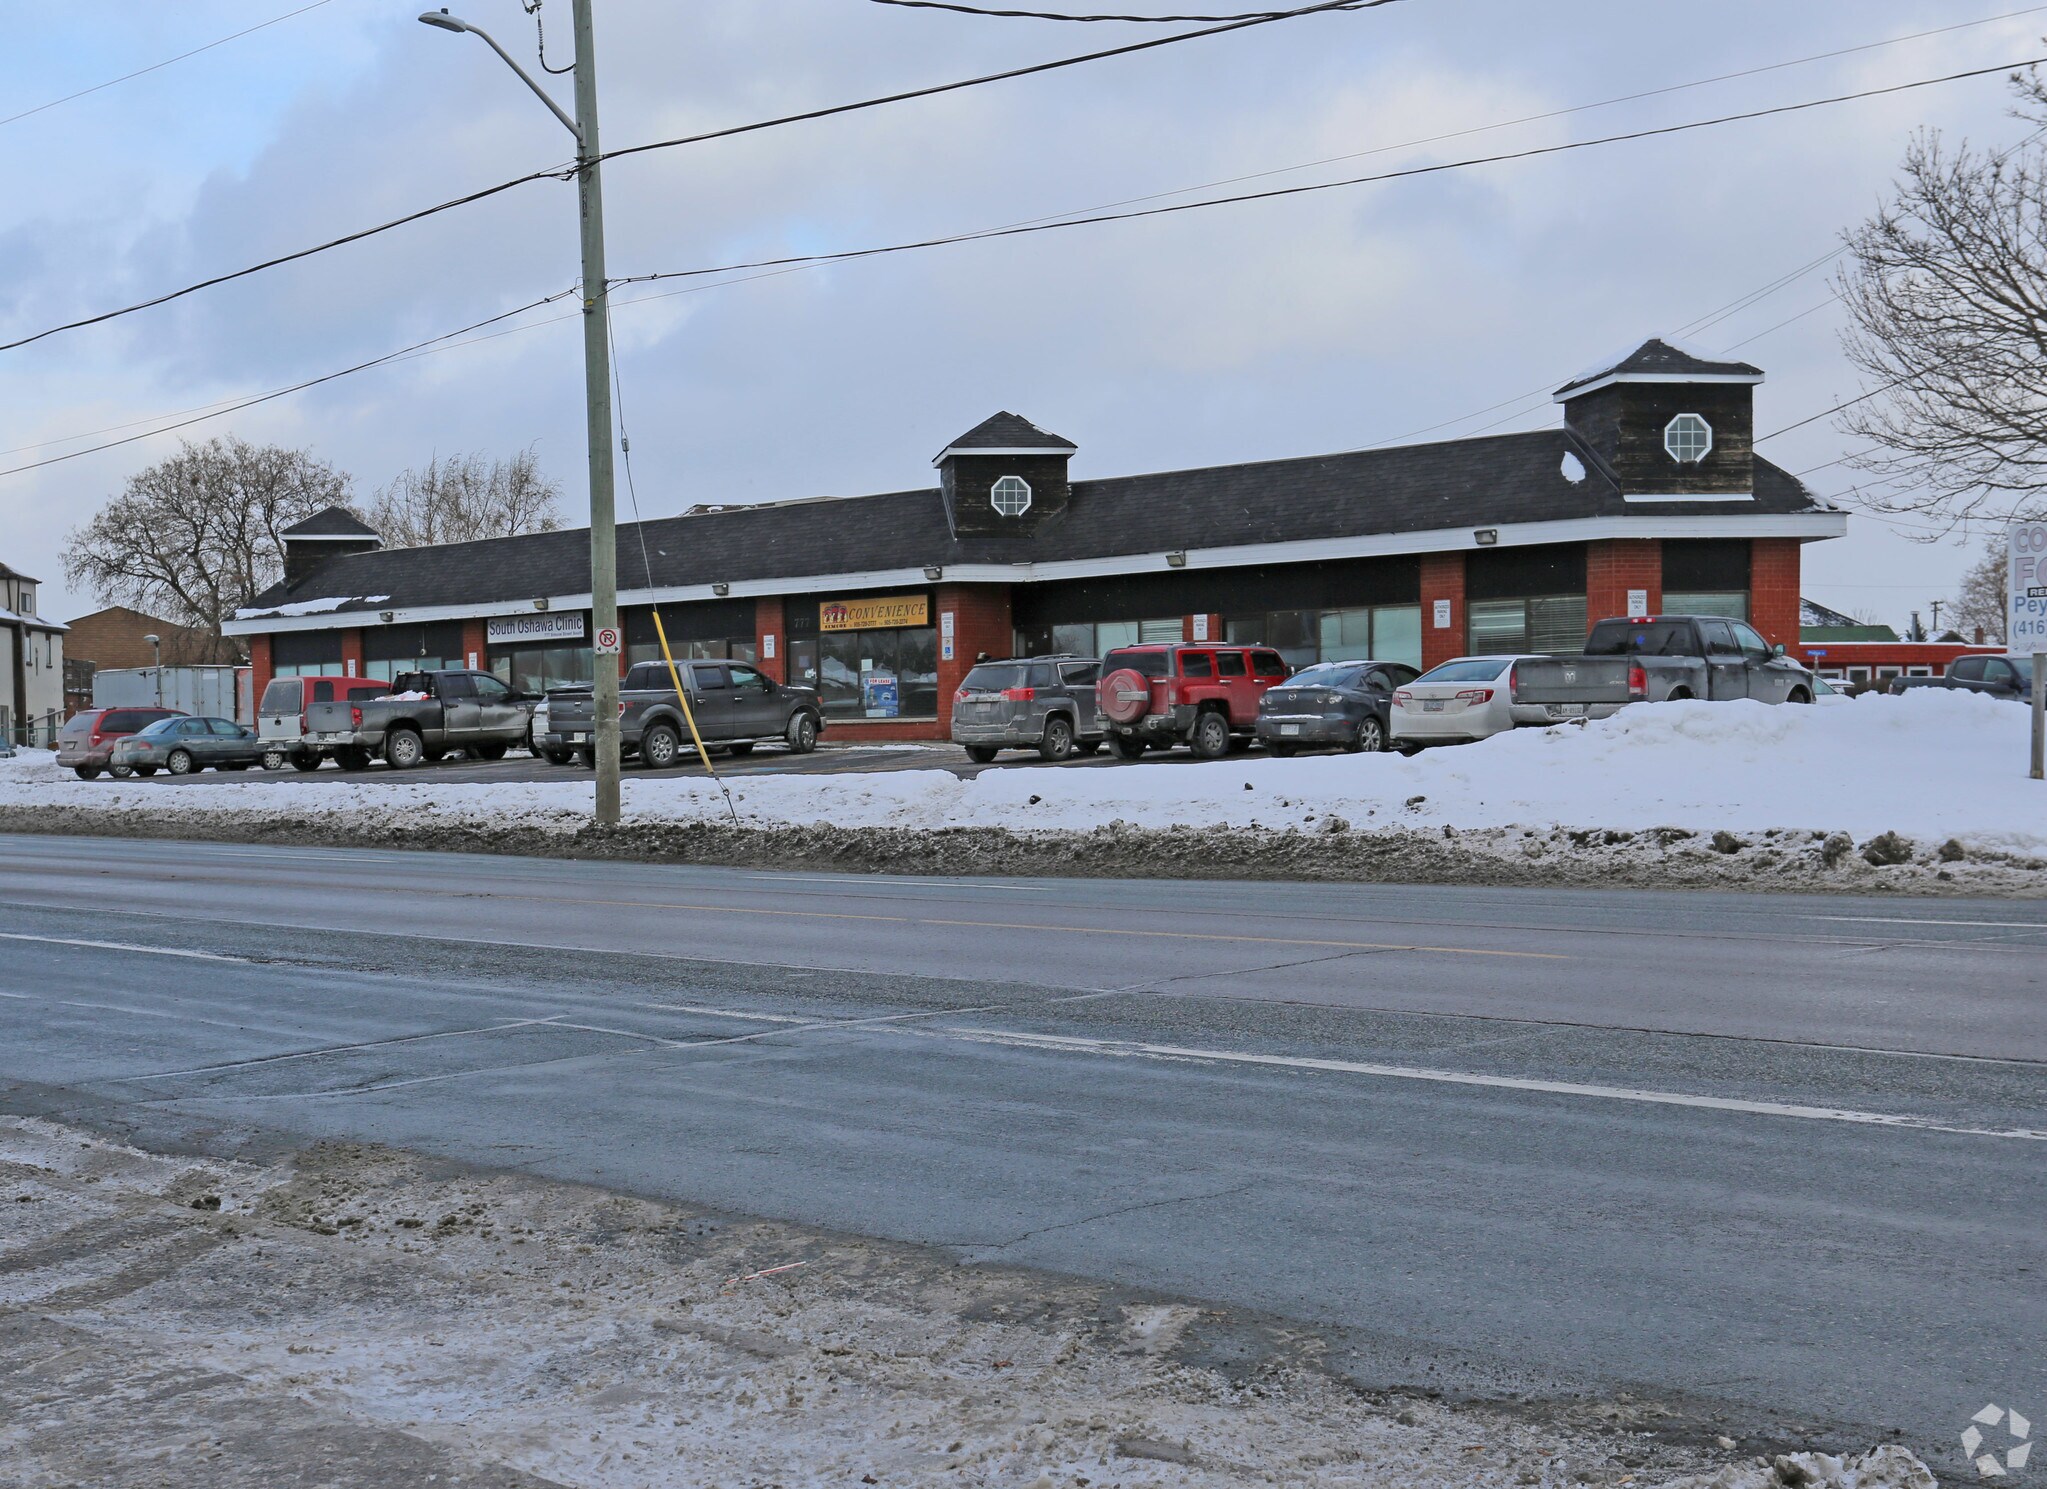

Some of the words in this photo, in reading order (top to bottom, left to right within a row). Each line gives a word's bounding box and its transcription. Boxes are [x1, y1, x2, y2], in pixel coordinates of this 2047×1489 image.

[848, 603, 926, 620] CONVENIENCE
[489, 621, 515, 635] South
[517, 619, 553, 634] Oshawa
[555, 616, 582, 631] Clinic
[794, 618, 810, 629] 777
